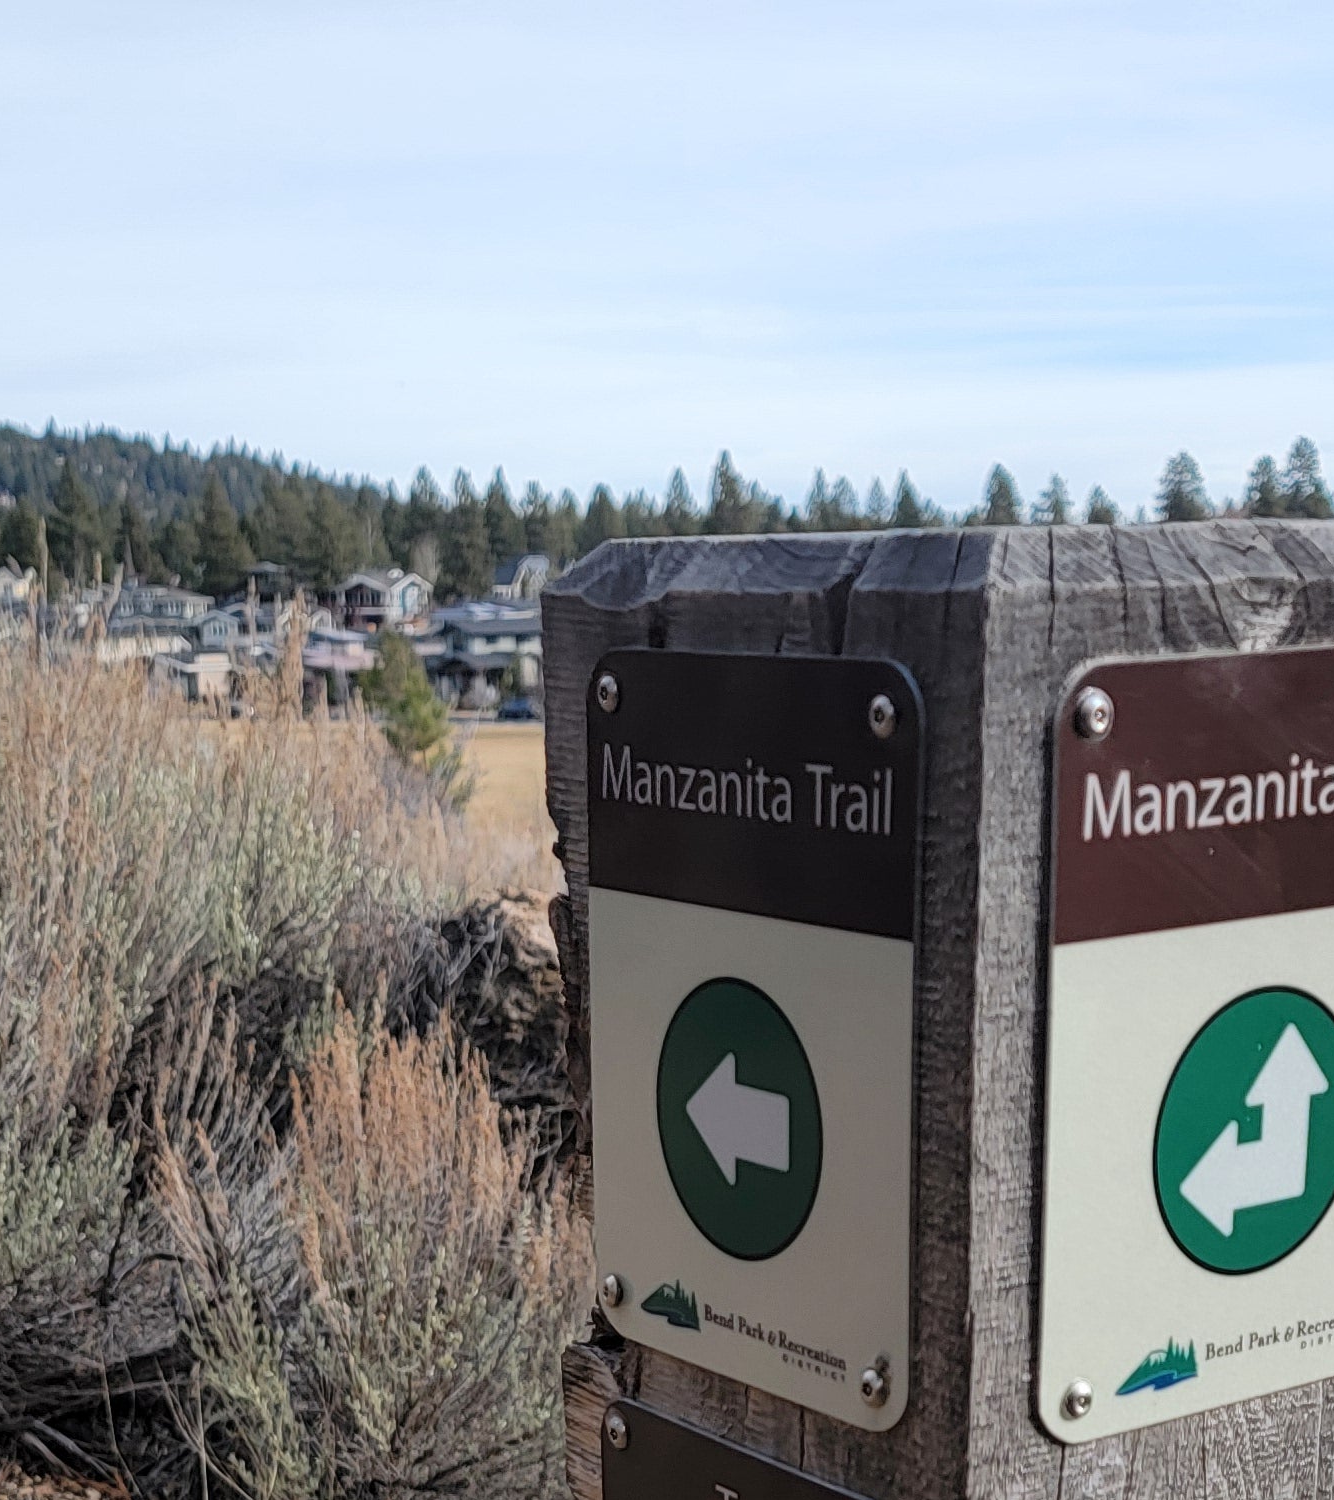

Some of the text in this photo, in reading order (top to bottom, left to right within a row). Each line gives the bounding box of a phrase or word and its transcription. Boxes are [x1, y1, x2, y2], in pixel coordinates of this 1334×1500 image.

[601, 742, 893, 836] Manzanita Trail
[704, 1303, 847, 1371] Bend Park & Recreation
[1205, 1335, 1244, 1361] Bend
[1248, 1327, 1281, 1350] Park
[1284, 1326, 1295, 1343] &
